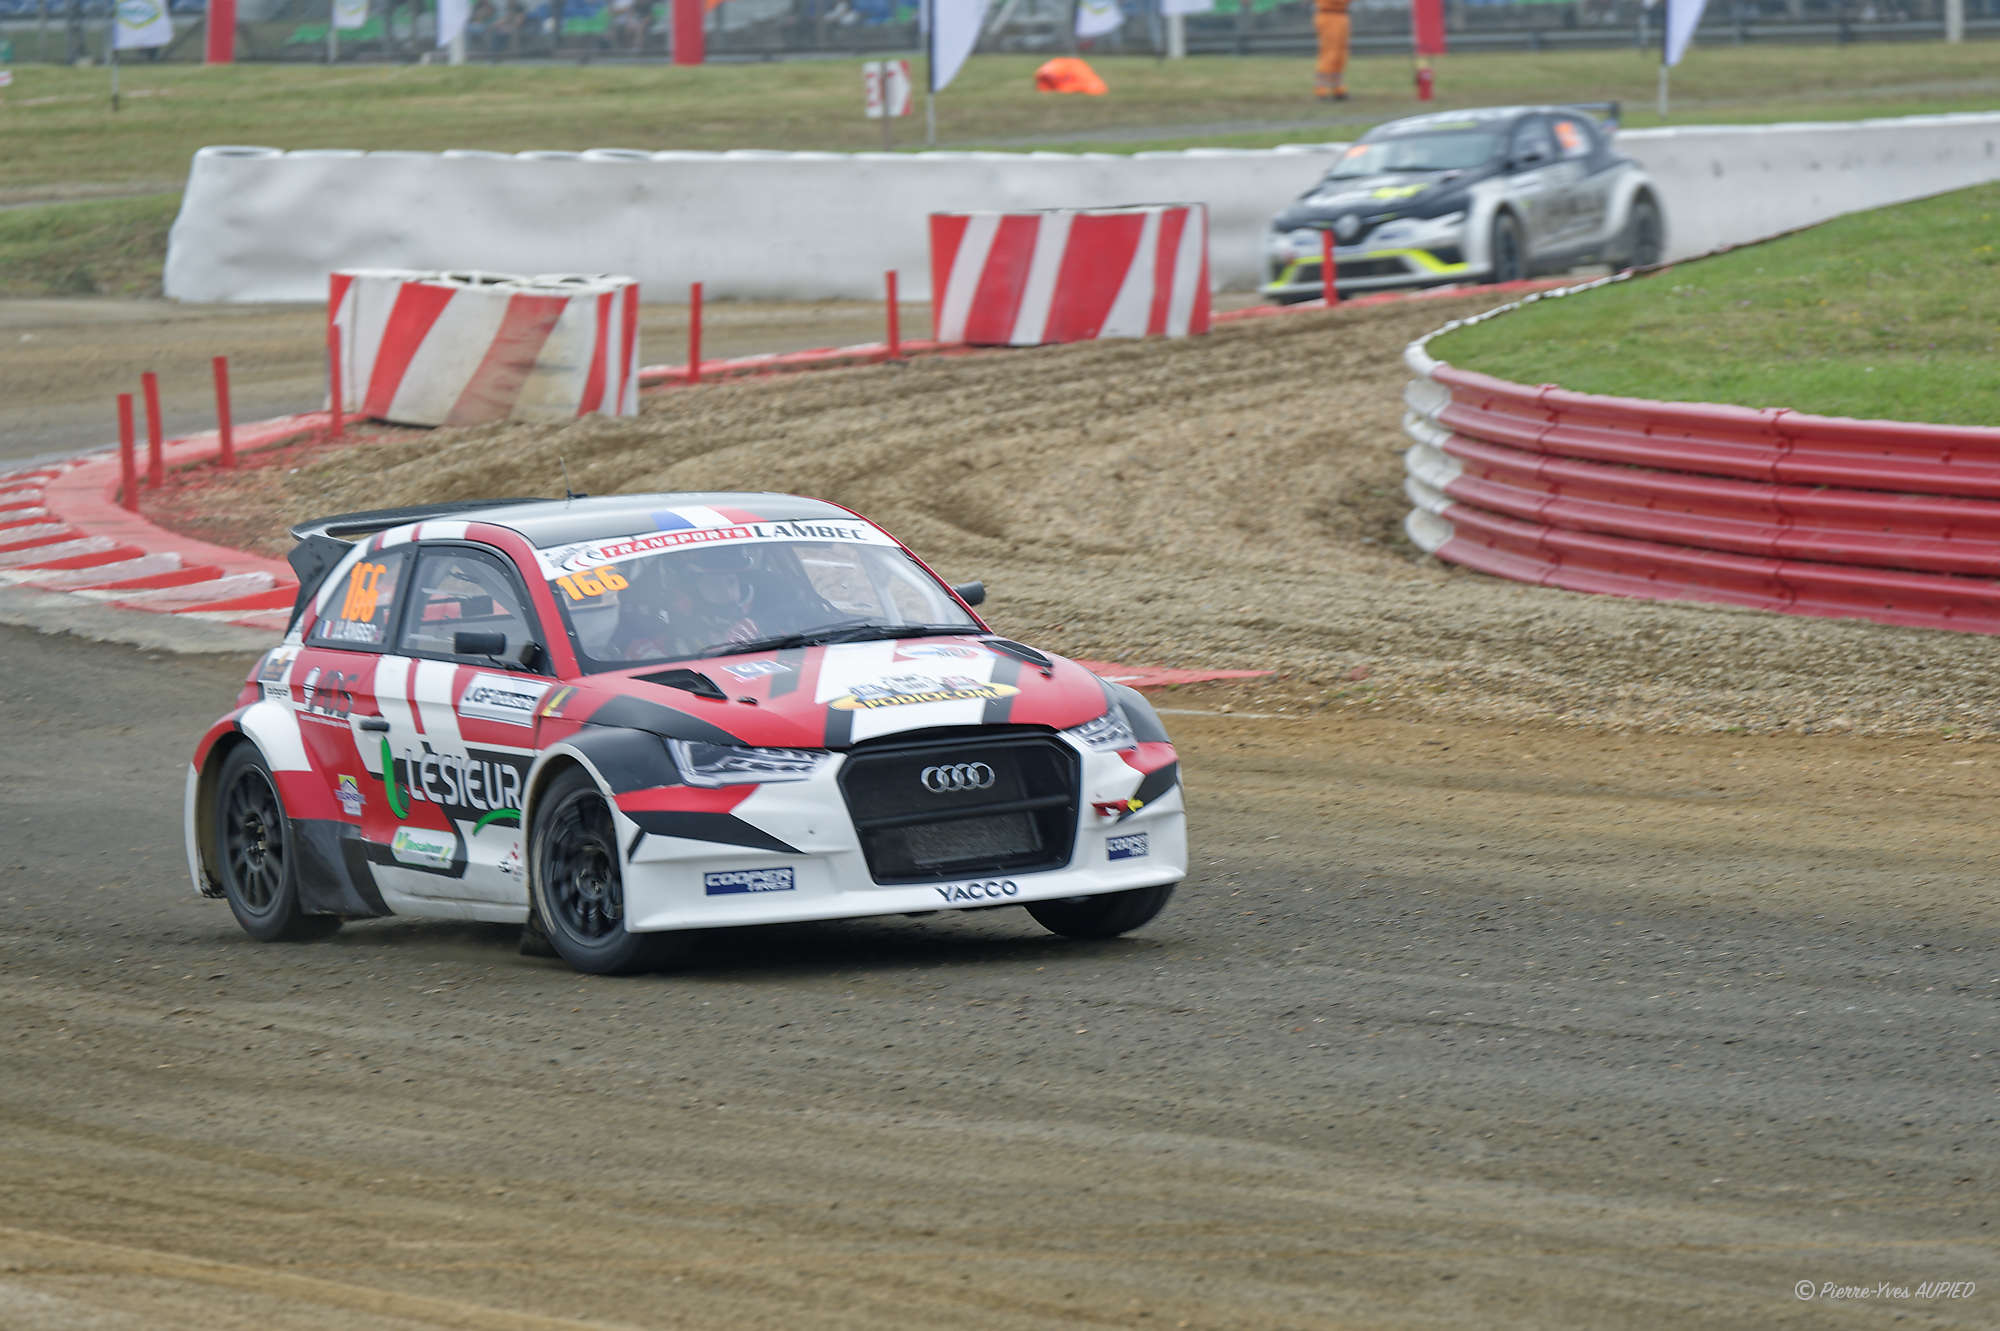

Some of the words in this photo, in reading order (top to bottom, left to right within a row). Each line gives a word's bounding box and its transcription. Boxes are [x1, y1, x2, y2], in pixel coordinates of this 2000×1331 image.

[602, 526, 752, 558] TRANSPORTS
[753, 521, 868, 541] LAMBEC
[341, 561, 387, 622] 166
[556, 565, 630, 601] 166
[405, 749, 523, 811] LESIEUR
[706, 868, 793, 887] COOPER
[934, 879, 1019, 903] YACCO
